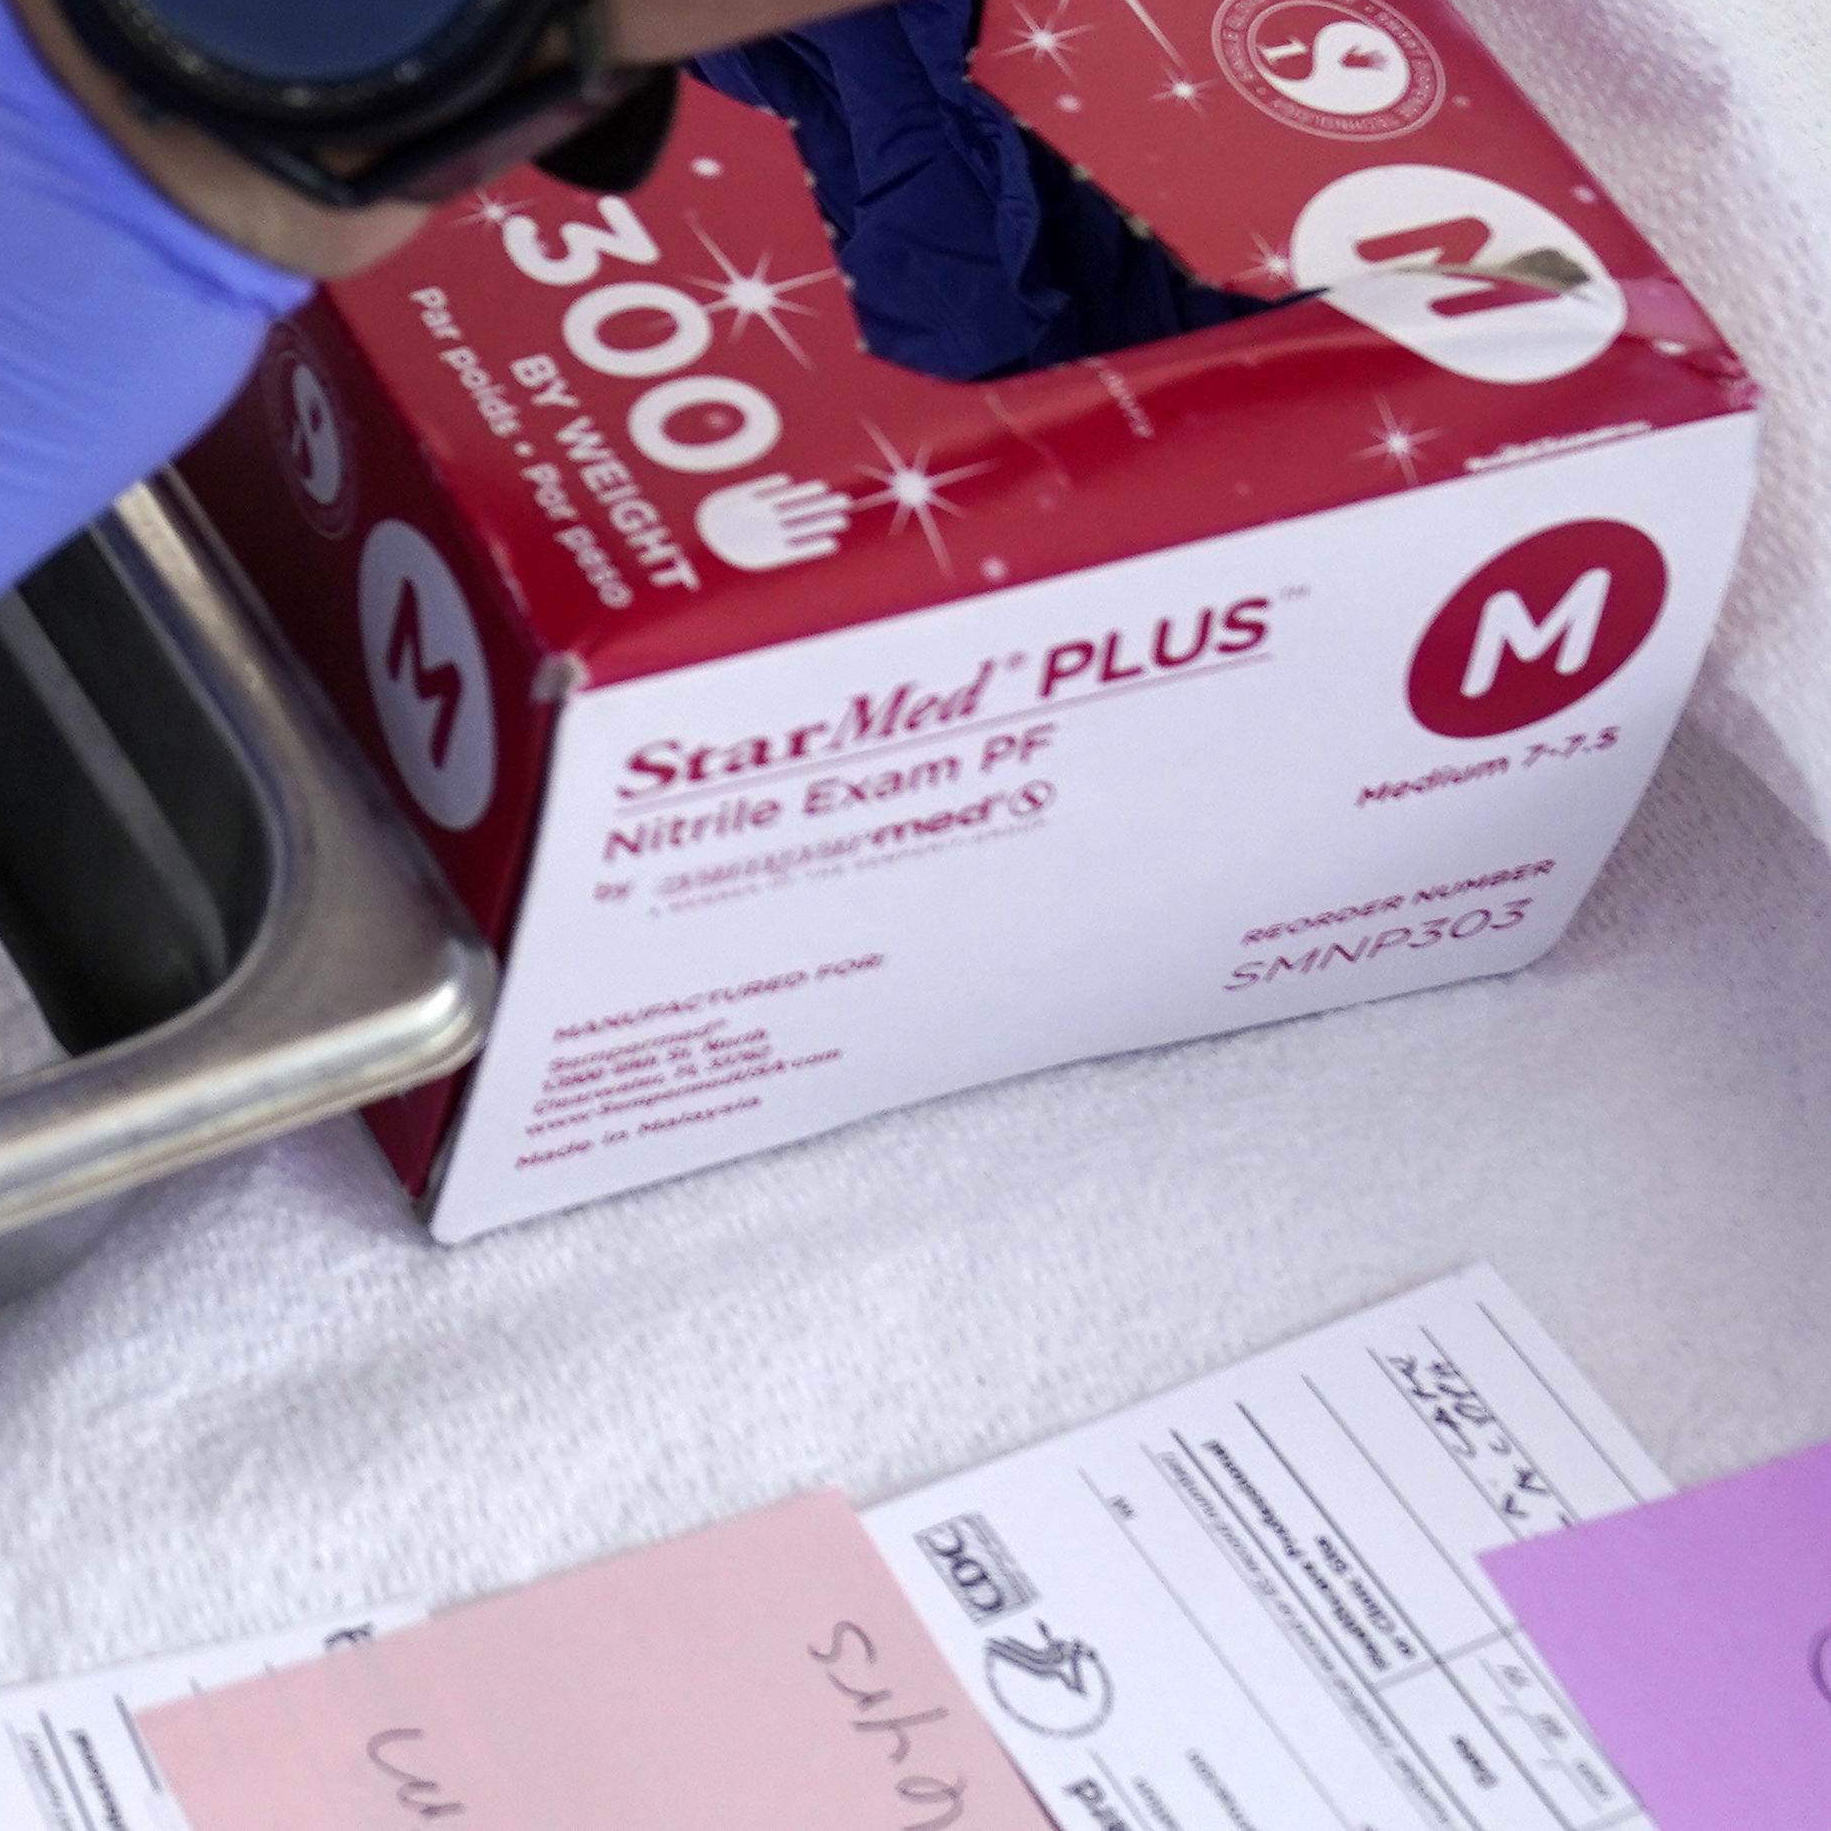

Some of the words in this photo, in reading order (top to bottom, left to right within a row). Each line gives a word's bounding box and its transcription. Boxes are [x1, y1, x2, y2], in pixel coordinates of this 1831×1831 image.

[493, 195, 781, 473] 300
[410, 286, 462, 340] Par
[440, 346, 522, 437] poids
[522, 462, 577, 519] Por
[555, 525, 633, 608] peso
[510, 354, 579, 408] BY
[555, 415, 699, 589] WEIGHT
[1460, 567, 1612, 698] M
[603, 799, 783, 862] Nitrile
[801, 755, 962, 819] Exam
[980, 722, 1056, 773] PF
[1356, 756, 1510, 807] Medium
[1523, 725, 1622, 768] 7-7.5
[1223, 896, 1535, 991] SMNP303
[1242, 894, 1406, 946] REORDER
[1412, 858, 1557, 905] NUMBER
[552, 970, 810, 1043] MANUFACTURED
